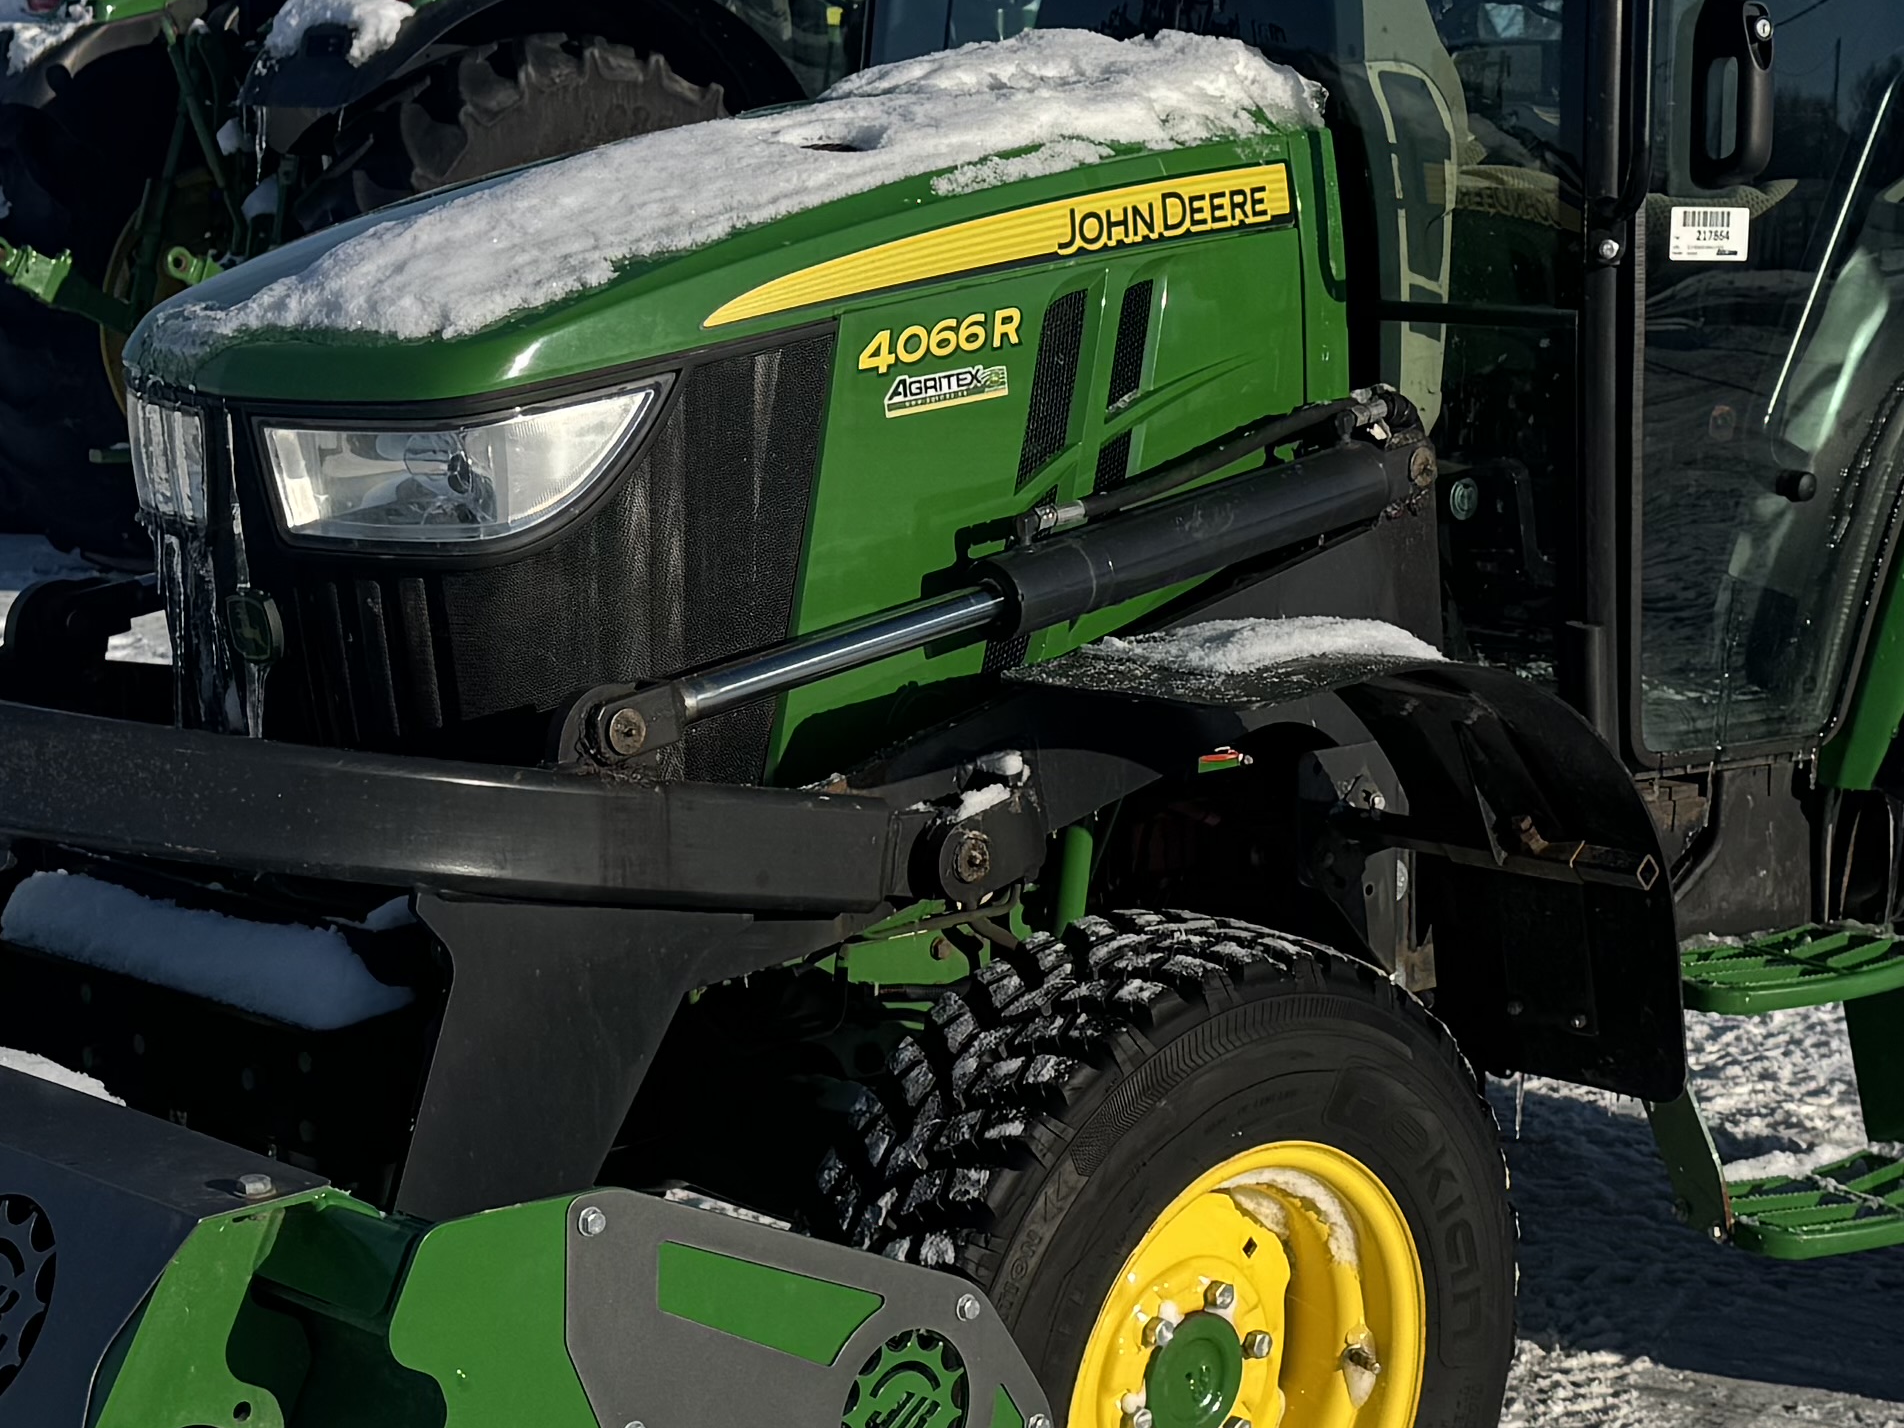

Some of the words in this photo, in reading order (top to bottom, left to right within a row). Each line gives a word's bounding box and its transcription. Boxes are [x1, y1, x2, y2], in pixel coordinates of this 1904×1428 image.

[1057, 202, 1155, 250] JOHN
[1161, 185, 1267, 233] DEERE
[858, 313, 985, 374] 4066
[993, 307, 1021, 348] R
[889, 369, 982, 401] AGRITEX
